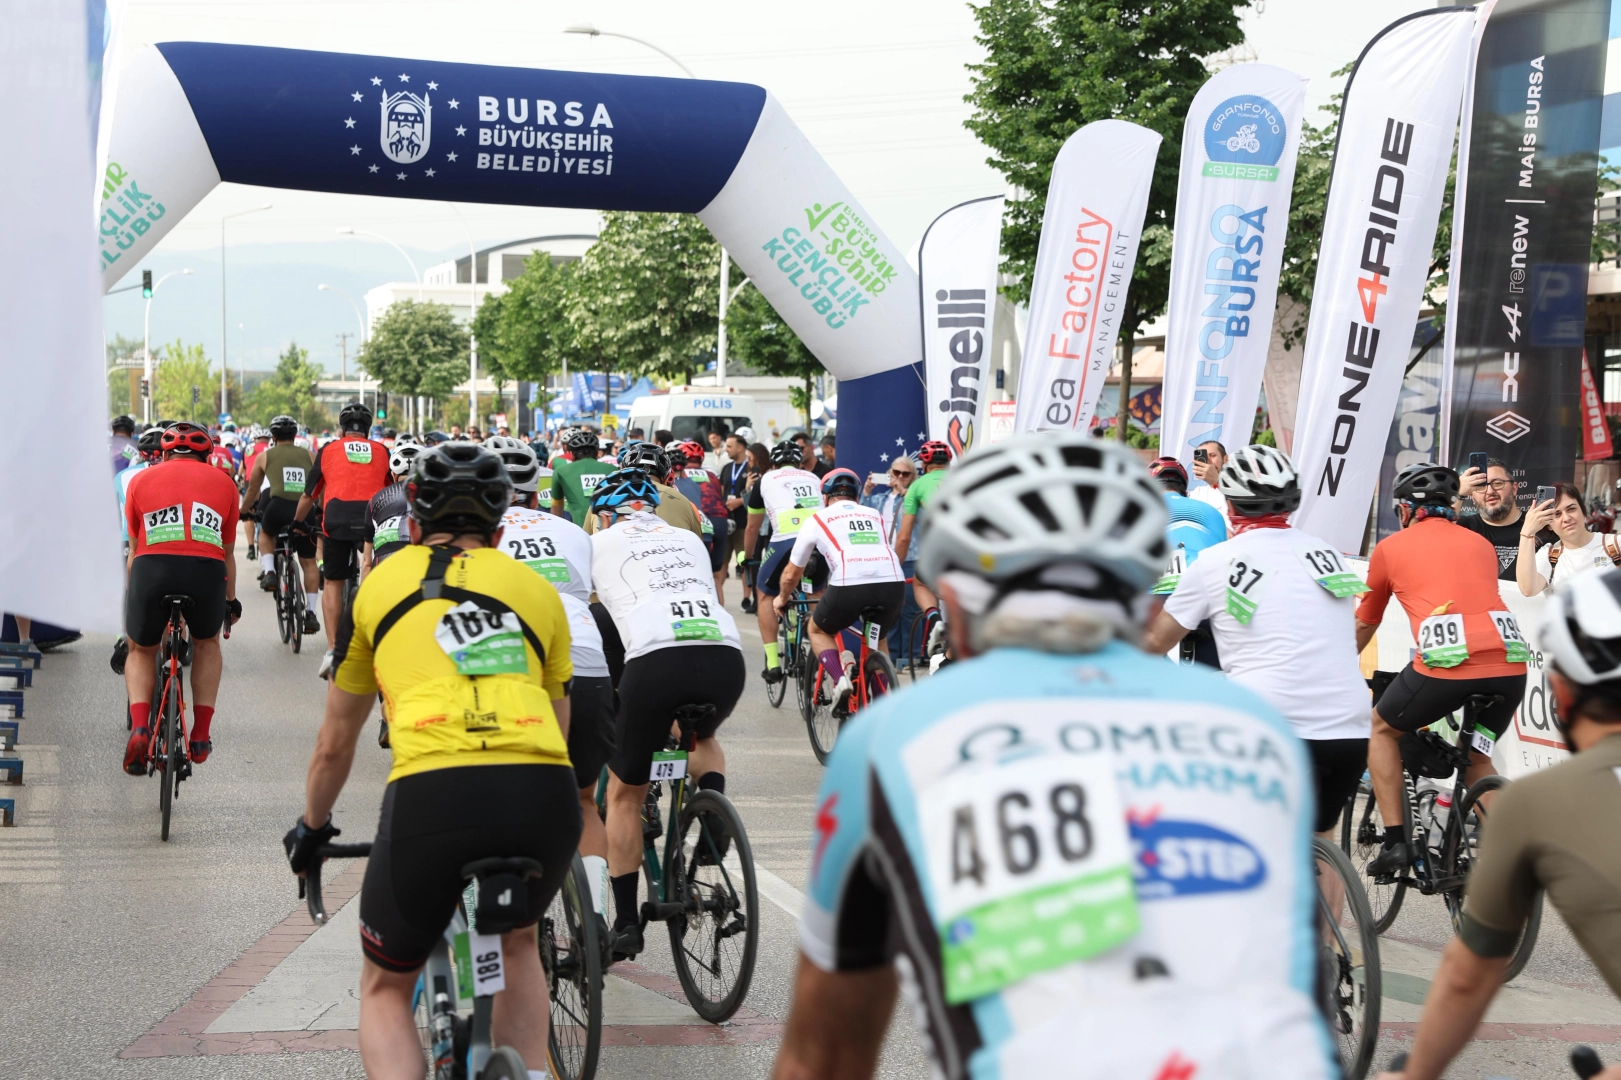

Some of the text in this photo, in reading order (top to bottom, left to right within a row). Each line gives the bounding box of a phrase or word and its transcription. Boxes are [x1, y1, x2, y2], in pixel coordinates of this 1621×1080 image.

[1524, 55, 1545, 129] BURSA
[478, 96, 614, 129] BURSA
[1213, 103, 1279, 134] GRANFONDO
[478, 124, 614, 153] BÜYÜKŞEHİR
[476, 152, 613, 176] BELEDİYESİ
[1212, 165, 1269, 178] BURSA
[98, 180, 153, 246] ÇLİK
[98, 201, 166, 275] LÜBÜ
[1509, 214, 1530, 294] renew
[762, 237, 848, 329] KULÜBÜ
[782, 227, 870, 318] GENÇLİK
[1048, 206, 1114, 361] Factory
[1225, 205, 1269, 338] BURSA
[1092, 230, 1130, 371] MANAGEMENT
[1316, 117, 1415, 498] ZONE4RIDE
[1186, 204, 1249, 450] ANFONDO
[936, 288, 986, 459] cinelli
[693, 397, 732, 409] POLİS
[348, 443, 369, 453] 455
[285, 471, 303, 482] 292
[793, 486, 812, 497] 337
[849, 520, 873, 531] 489
[508, 536, 556, 560] 253
[1305, 549, 1344, 575] 137
[1228, 557, 1264, 594] 37
[670, 600, 710, 618] 479
[1421, 621, 1459, 649] 299
[1060, 721, 1290, 773] OMEGA
[1522, 751, 1564, 769] EVE
[1116, 761, 1289, 812] HARMA
[951, 783, 1094, 889] 468
[476, 951, 501, 983] 186
